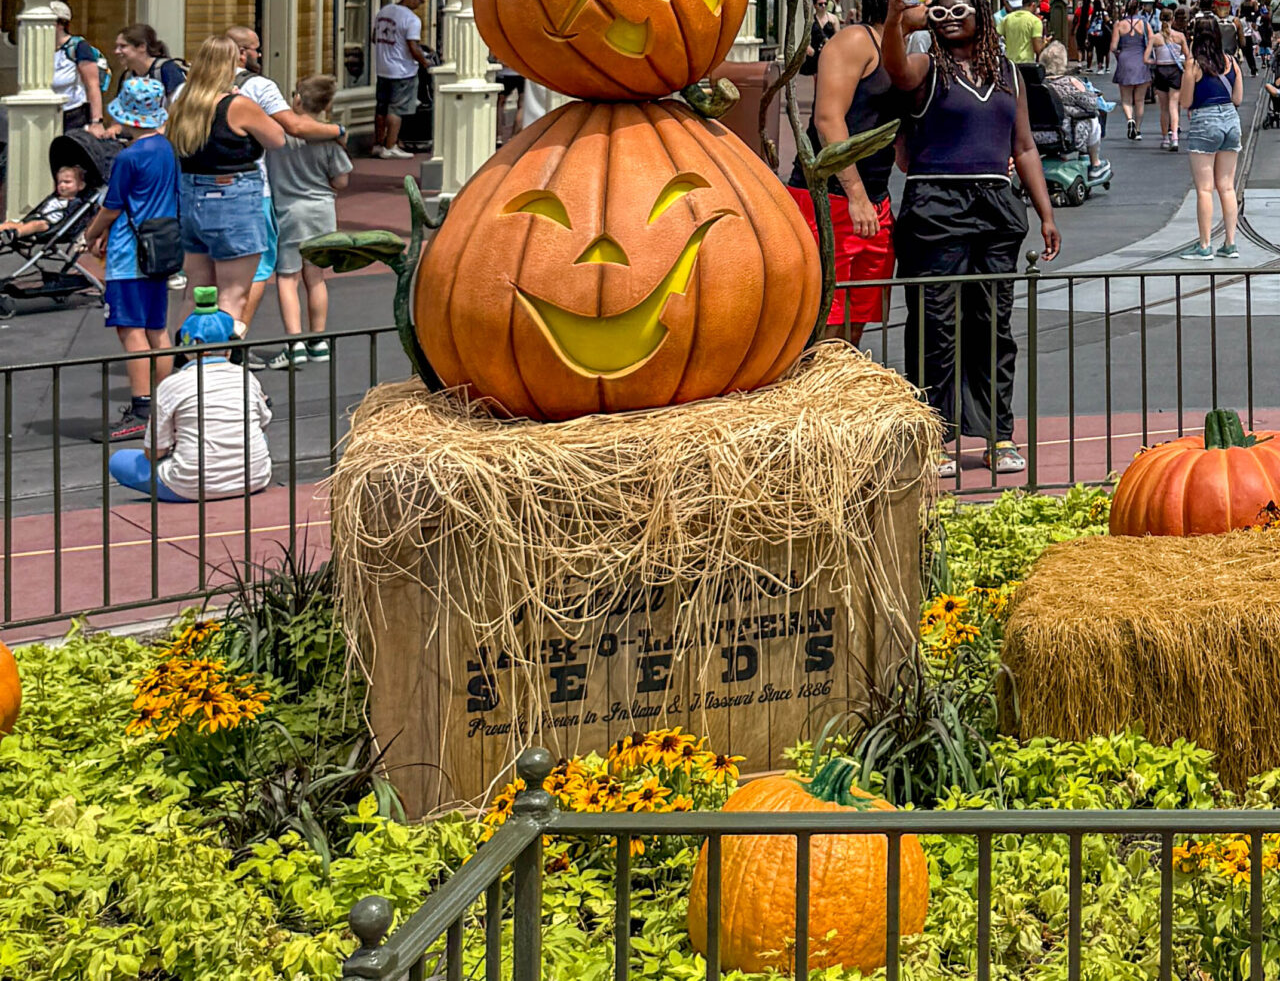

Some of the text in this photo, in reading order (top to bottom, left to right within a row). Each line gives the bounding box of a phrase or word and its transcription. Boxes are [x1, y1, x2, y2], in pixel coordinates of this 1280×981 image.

[467, 634, 836, 713] SEEDS
[584, 710, 597, 725] in
[602, 699, 663, 722] Indiana
[667, 694, 681, 715] &
[689, 690, 754, 713] Missouri
[758, 682, 794, 704] Since
[797, 679, 834, 699] 1886
